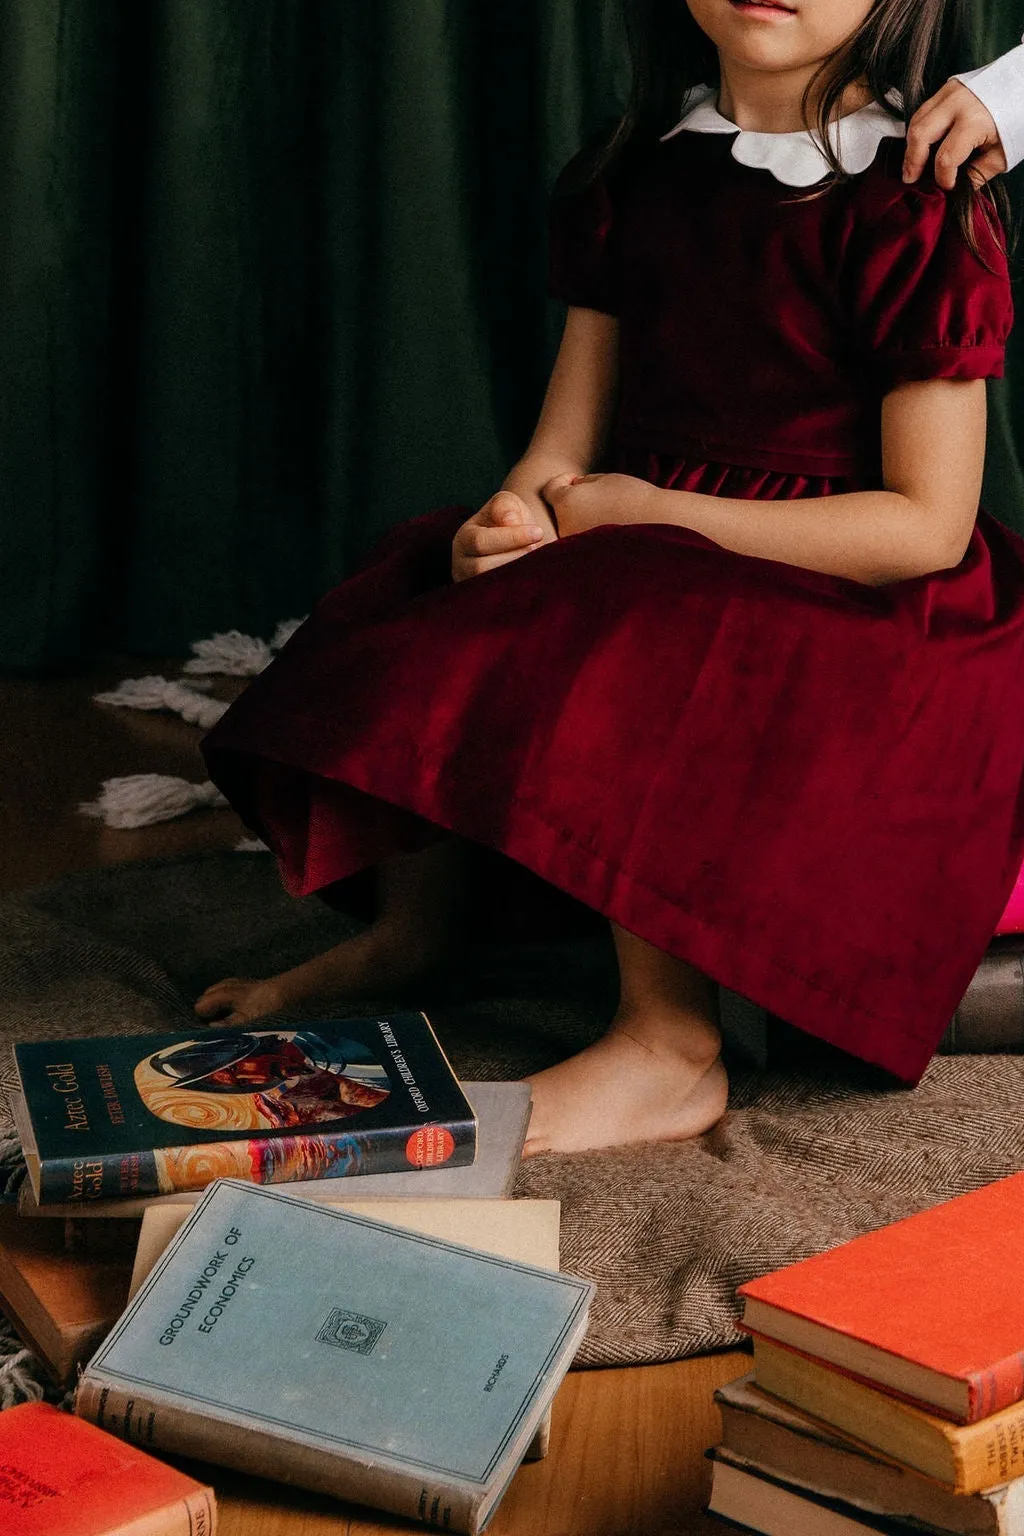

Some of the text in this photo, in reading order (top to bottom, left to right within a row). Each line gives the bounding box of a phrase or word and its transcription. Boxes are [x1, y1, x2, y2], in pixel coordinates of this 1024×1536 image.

[377, 1020, 430, 1113] OXFORD CHILDREN'S LIBRARY
[45, 1063, 91, 1131] Aztec Gold
[415, 1131, 424, 1165] OXFORD
[437, 1131, 445, 1162] LIBRARY
[68, 1159, 85, 1199] Aztec
[86, 1160, 104, 1199] Gold
[160, 1227, 242, 1346] GROUNDWORK OF
[198, 1256, 255, 1334] ECONOMICS
[483, 1353, 509, 1393] RICHARDS
[987, 1440, 997, 1466] THE
[1008, 1424, 1019, 1465] TWINS
